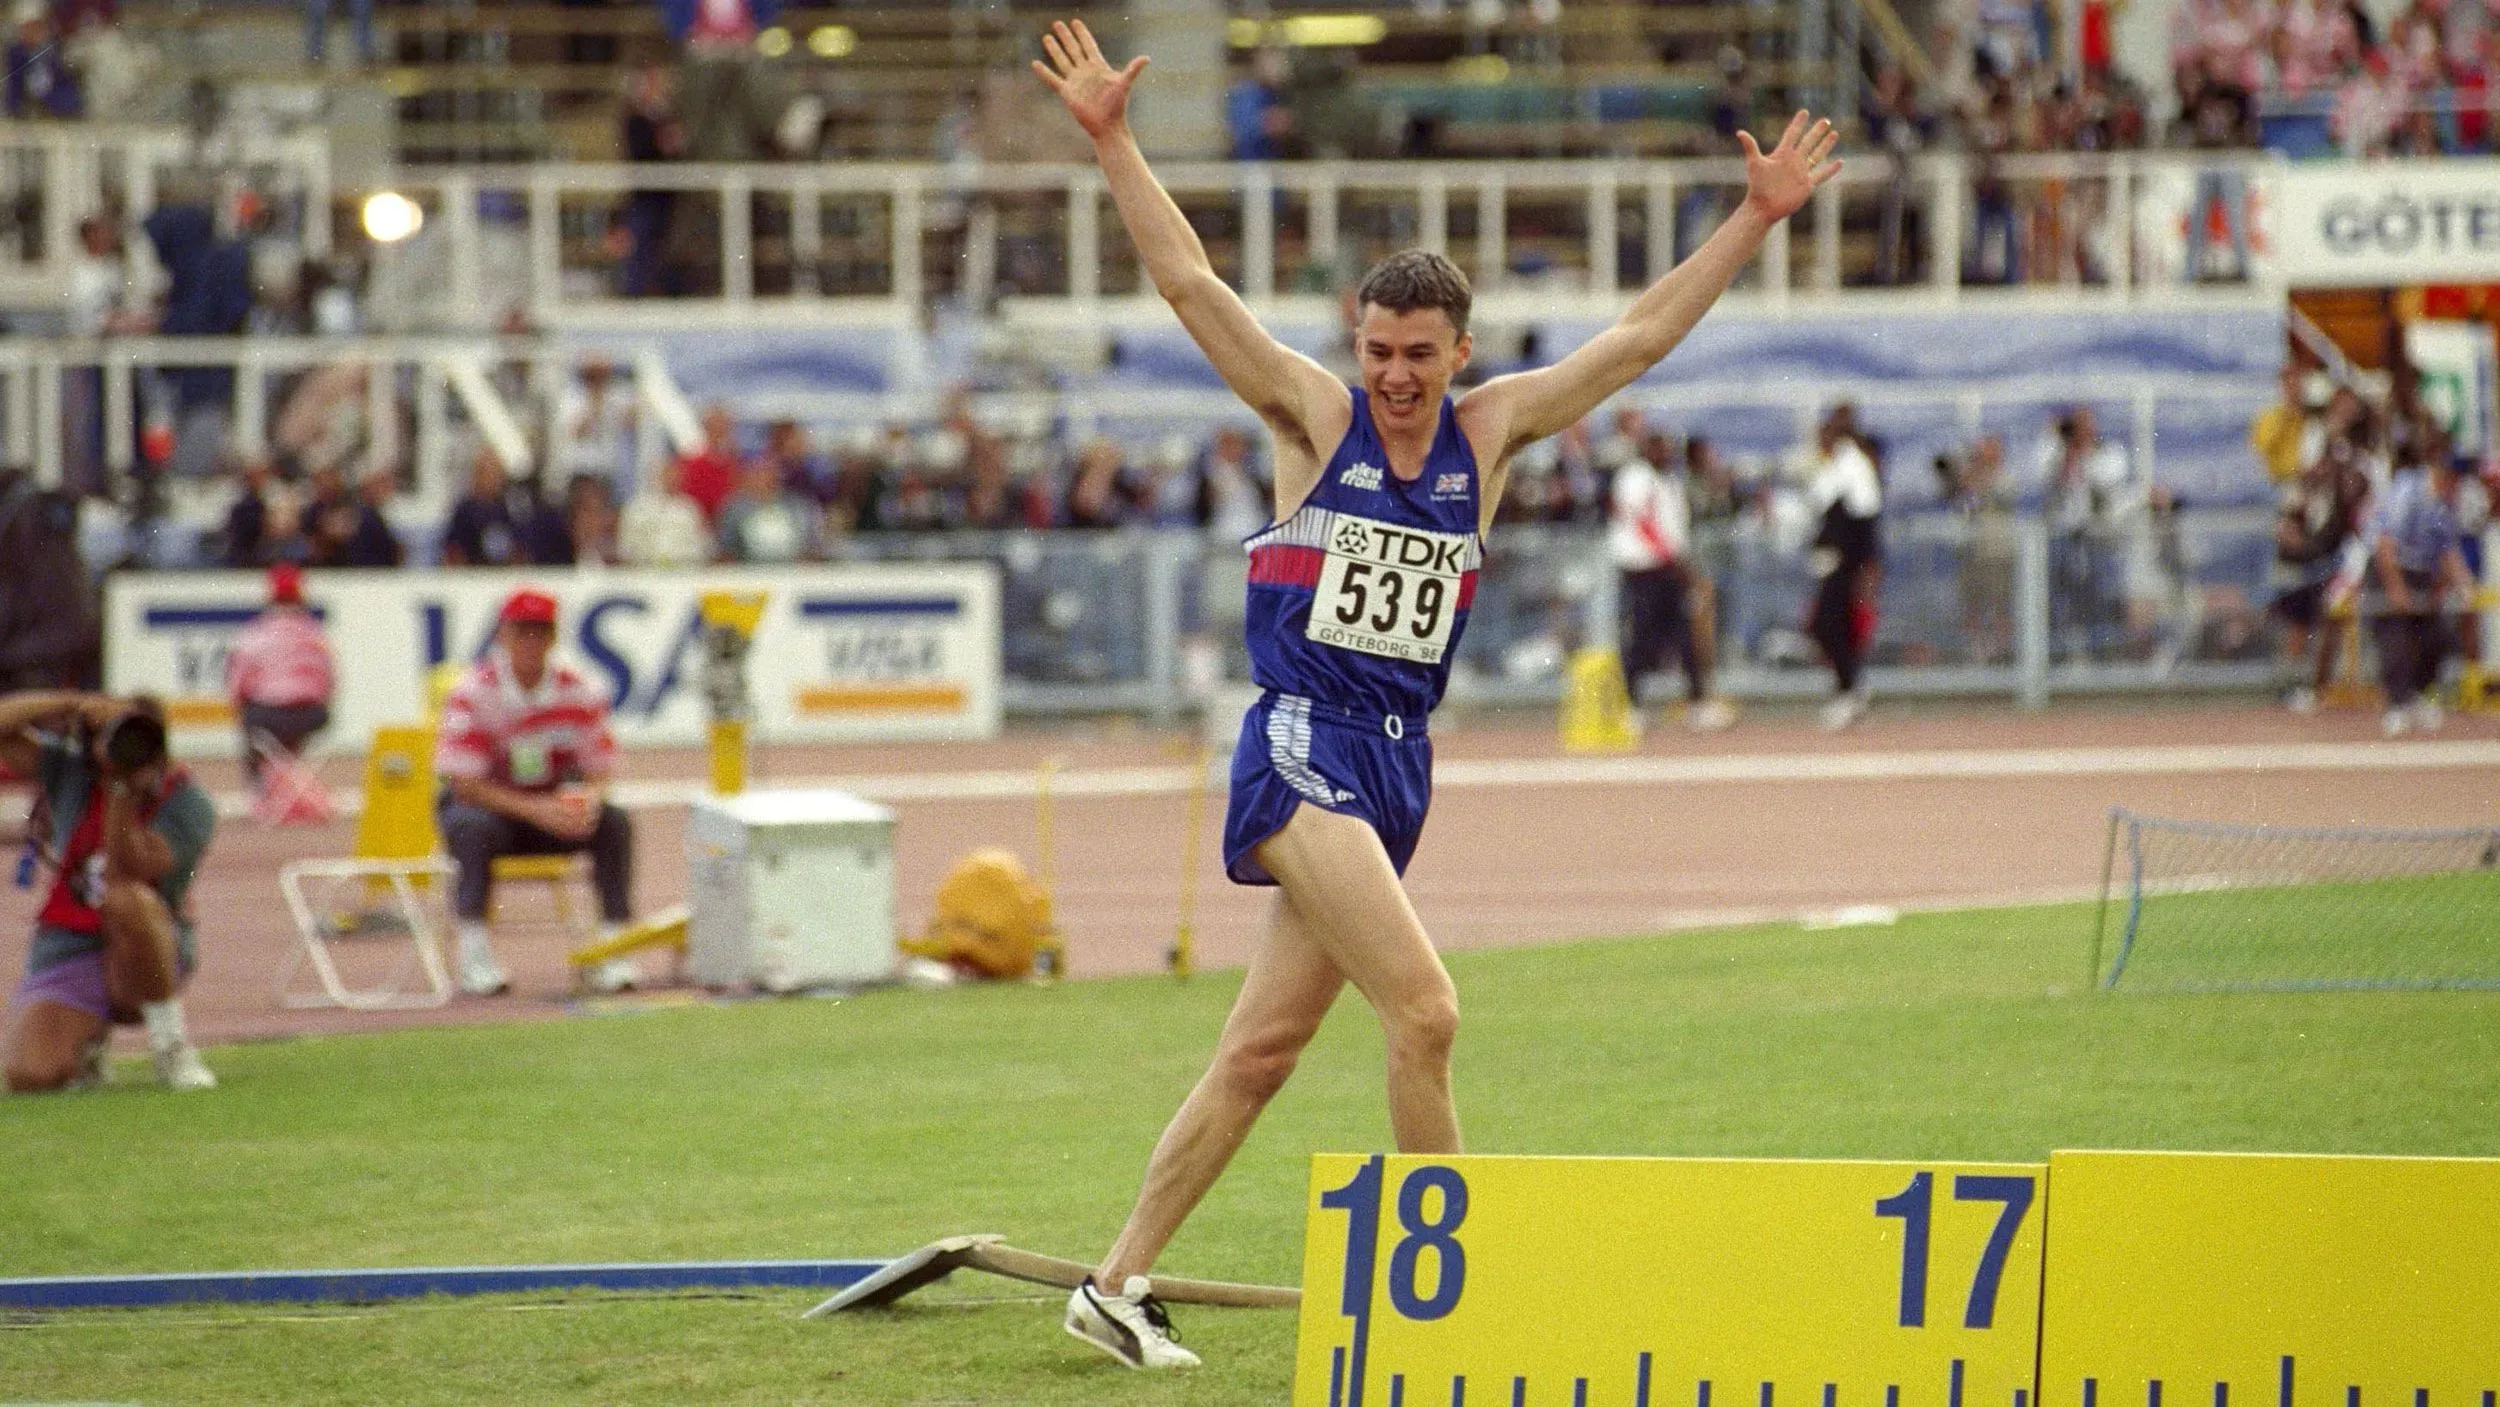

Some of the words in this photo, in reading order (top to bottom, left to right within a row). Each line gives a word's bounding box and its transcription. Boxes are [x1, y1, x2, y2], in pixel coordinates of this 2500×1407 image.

[1335, 561, 1444, 639] 539
[1372, 527, 1465, 574] TDK
[1320, 1155, 1469, 1321] 18
[1875, 1171, 2036, 1329] 17
